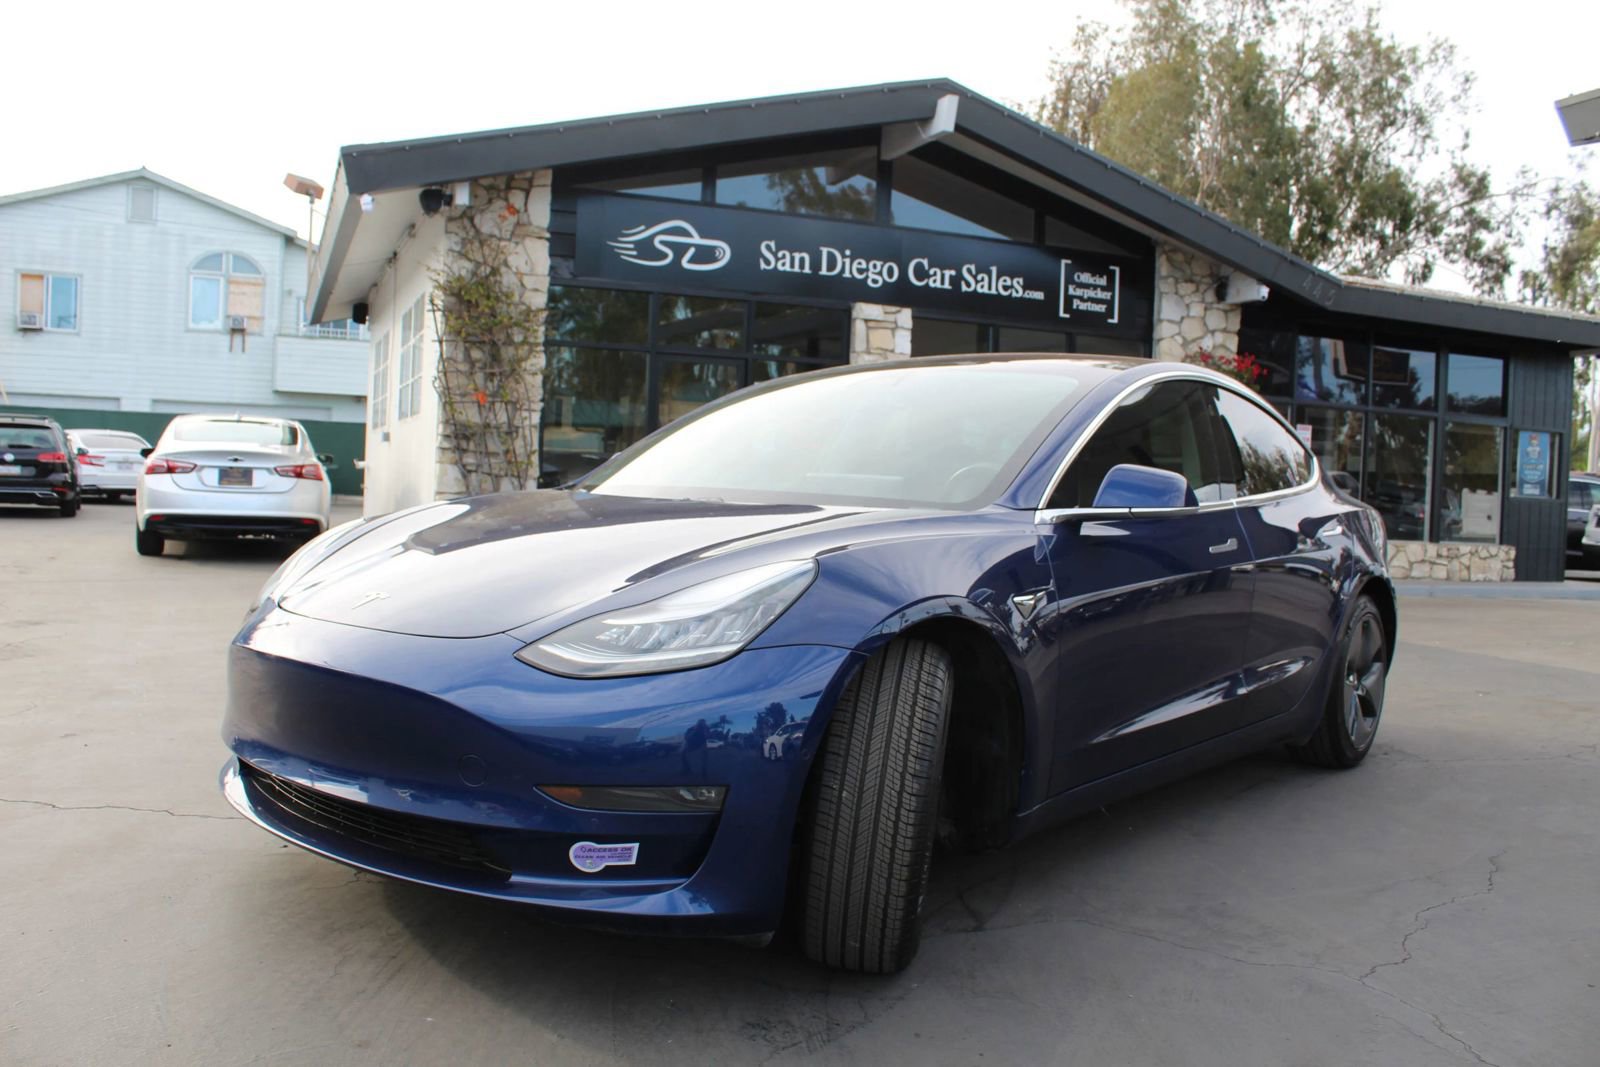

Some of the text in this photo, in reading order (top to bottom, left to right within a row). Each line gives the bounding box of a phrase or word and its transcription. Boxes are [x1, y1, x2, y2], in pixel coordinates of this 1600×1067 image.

[759, 239, 812, 275] San
[819, 246, 899, 288] Diego
[907, 257, 956, 290] Car
[1073, 271, 1108, 287] Official
[1067, 284, 1112, 300] Karpicker
[1072, 298, 1107, 313] Partner
